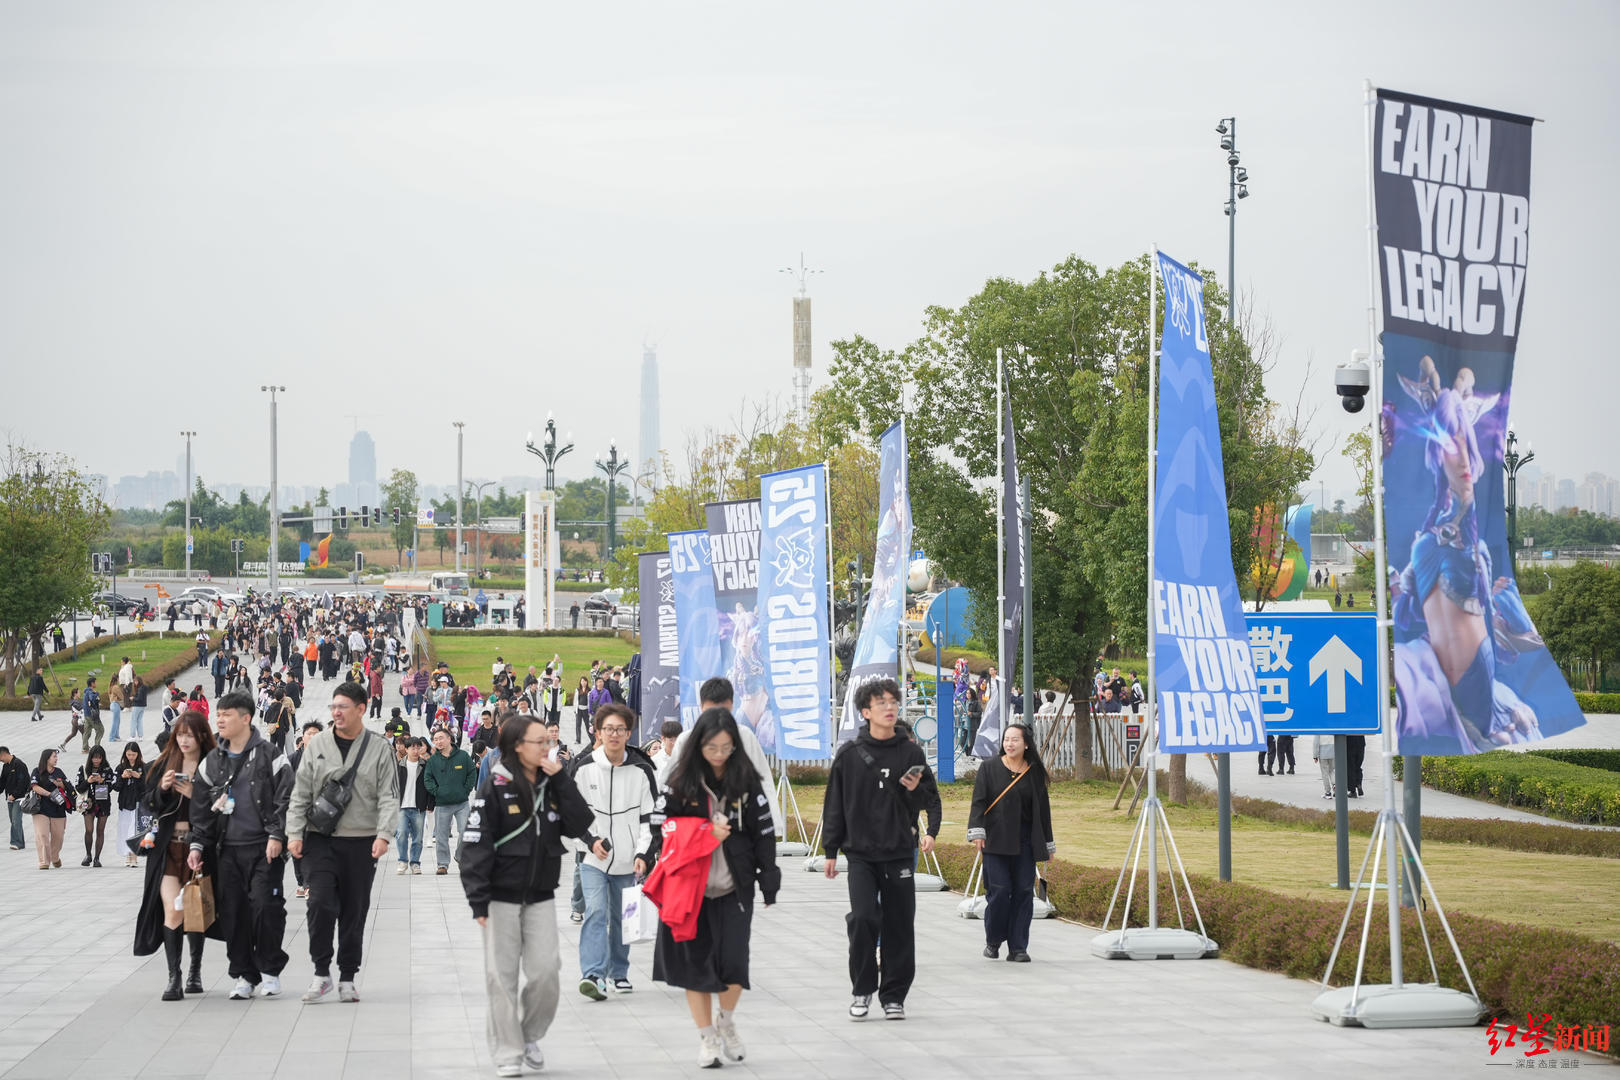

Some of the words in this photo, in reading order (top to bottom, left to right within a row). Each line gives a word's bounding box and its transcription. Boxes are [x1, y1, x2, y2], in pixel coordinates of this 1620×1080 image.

[1381, 98, 1491, 190] EARN
[1412, 178, 1529, 267] YOUR
[1383, 245, 1526, 337] LEGACY
[1154, 580, 1226, 638] EARN
[1176, 637, 1258, 692] YOUR
[1161, 690, 1265, 747] LEGACY
